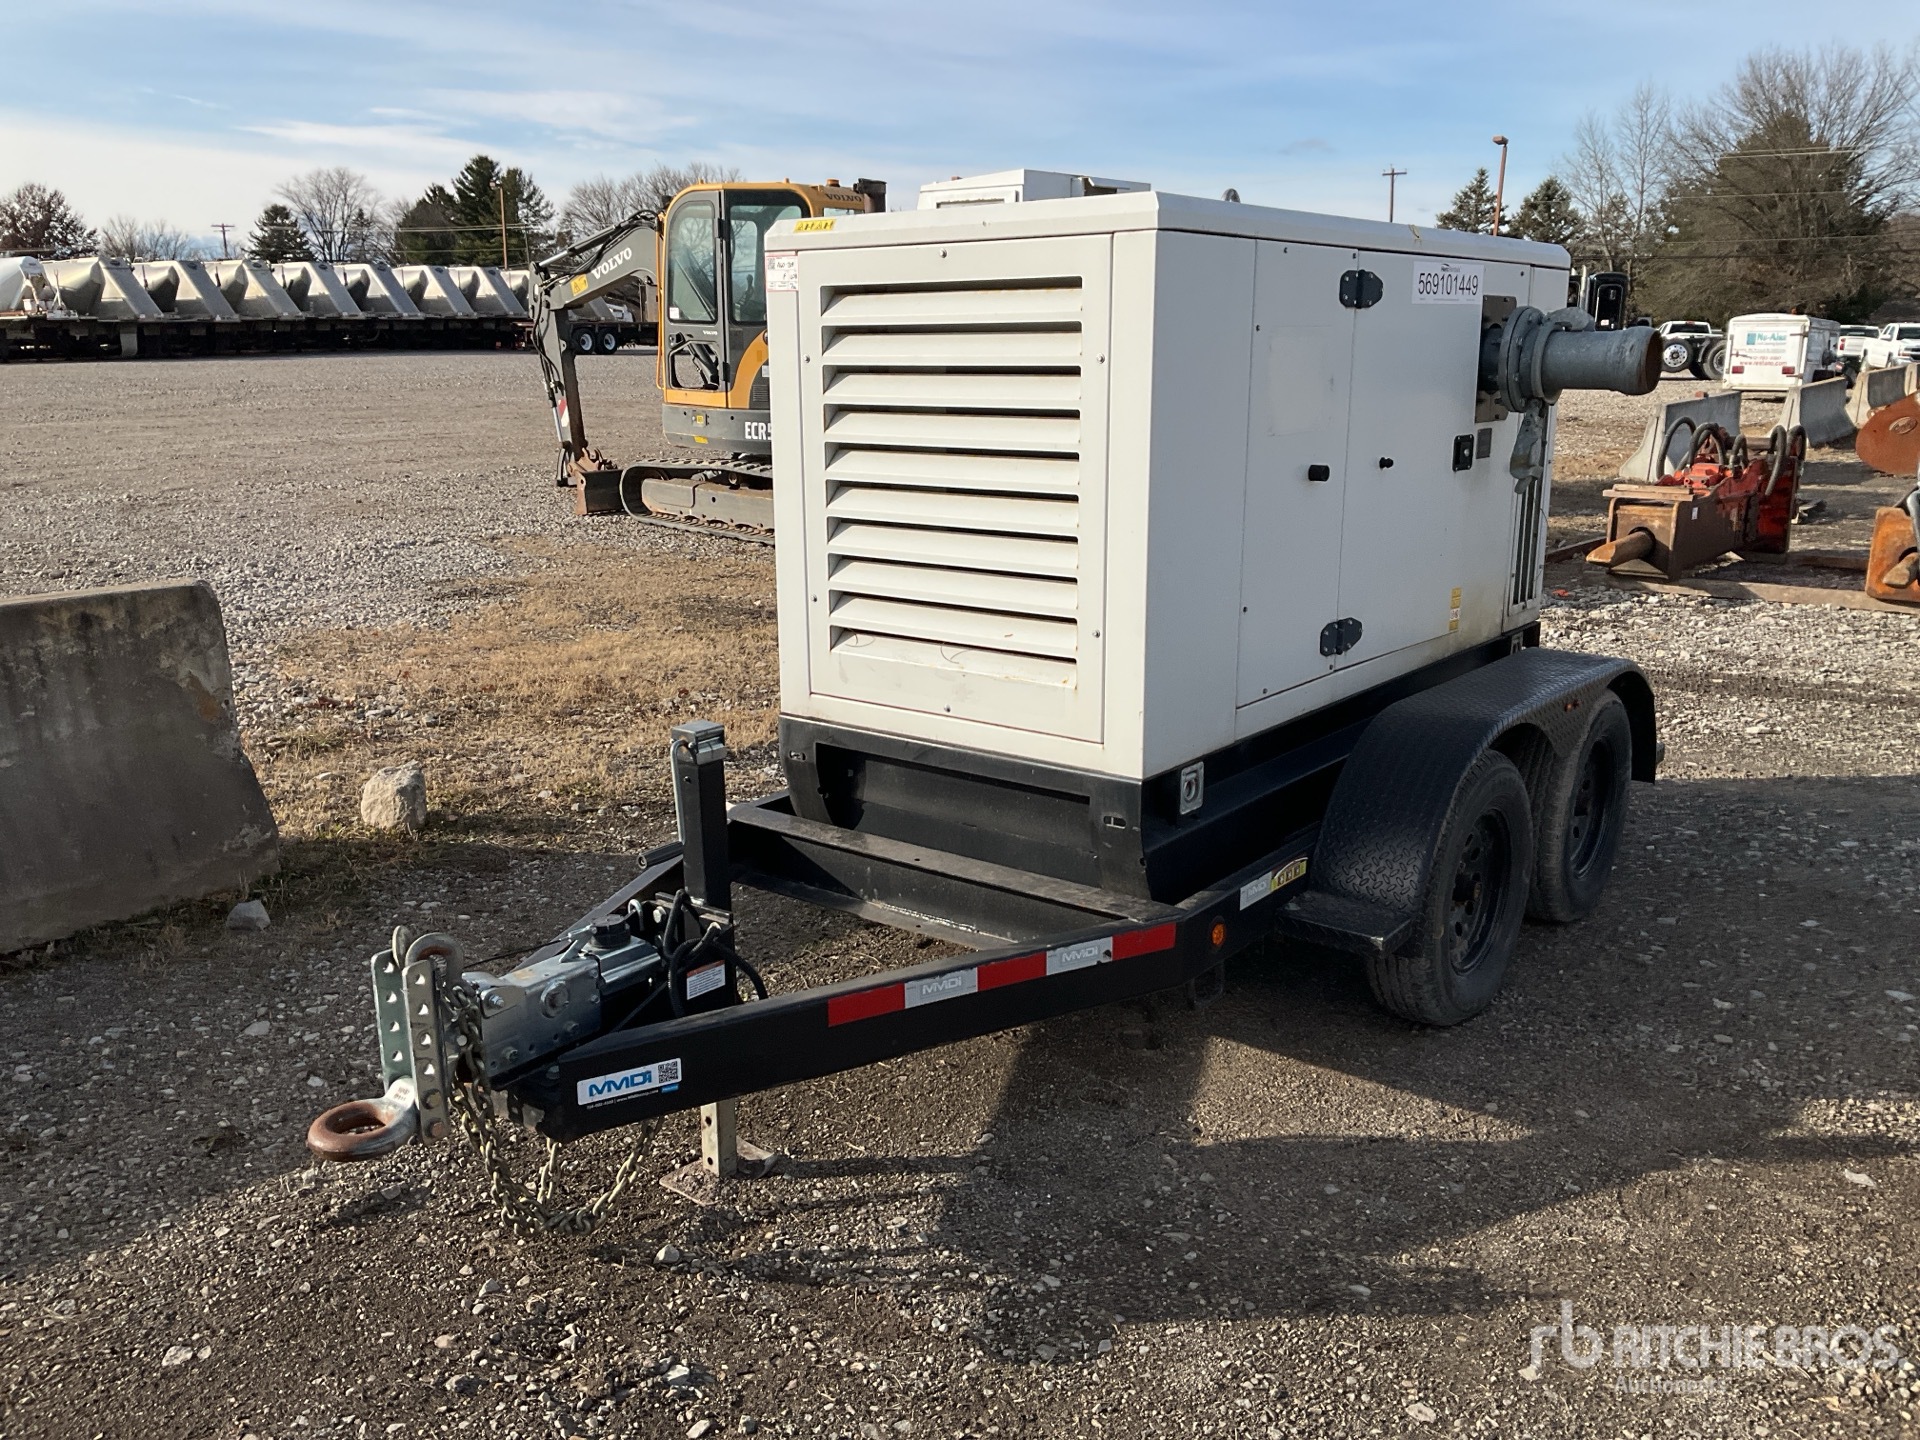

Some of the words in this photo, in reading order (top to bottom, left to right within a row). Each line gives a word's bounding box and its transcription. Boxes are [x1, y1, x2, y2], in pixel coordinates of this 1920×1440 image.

[823, 193, 862, 202] VOLVO
[591, 247, 632, 280] VOLVO
[1418, 272, 1479, 296] 569101449
